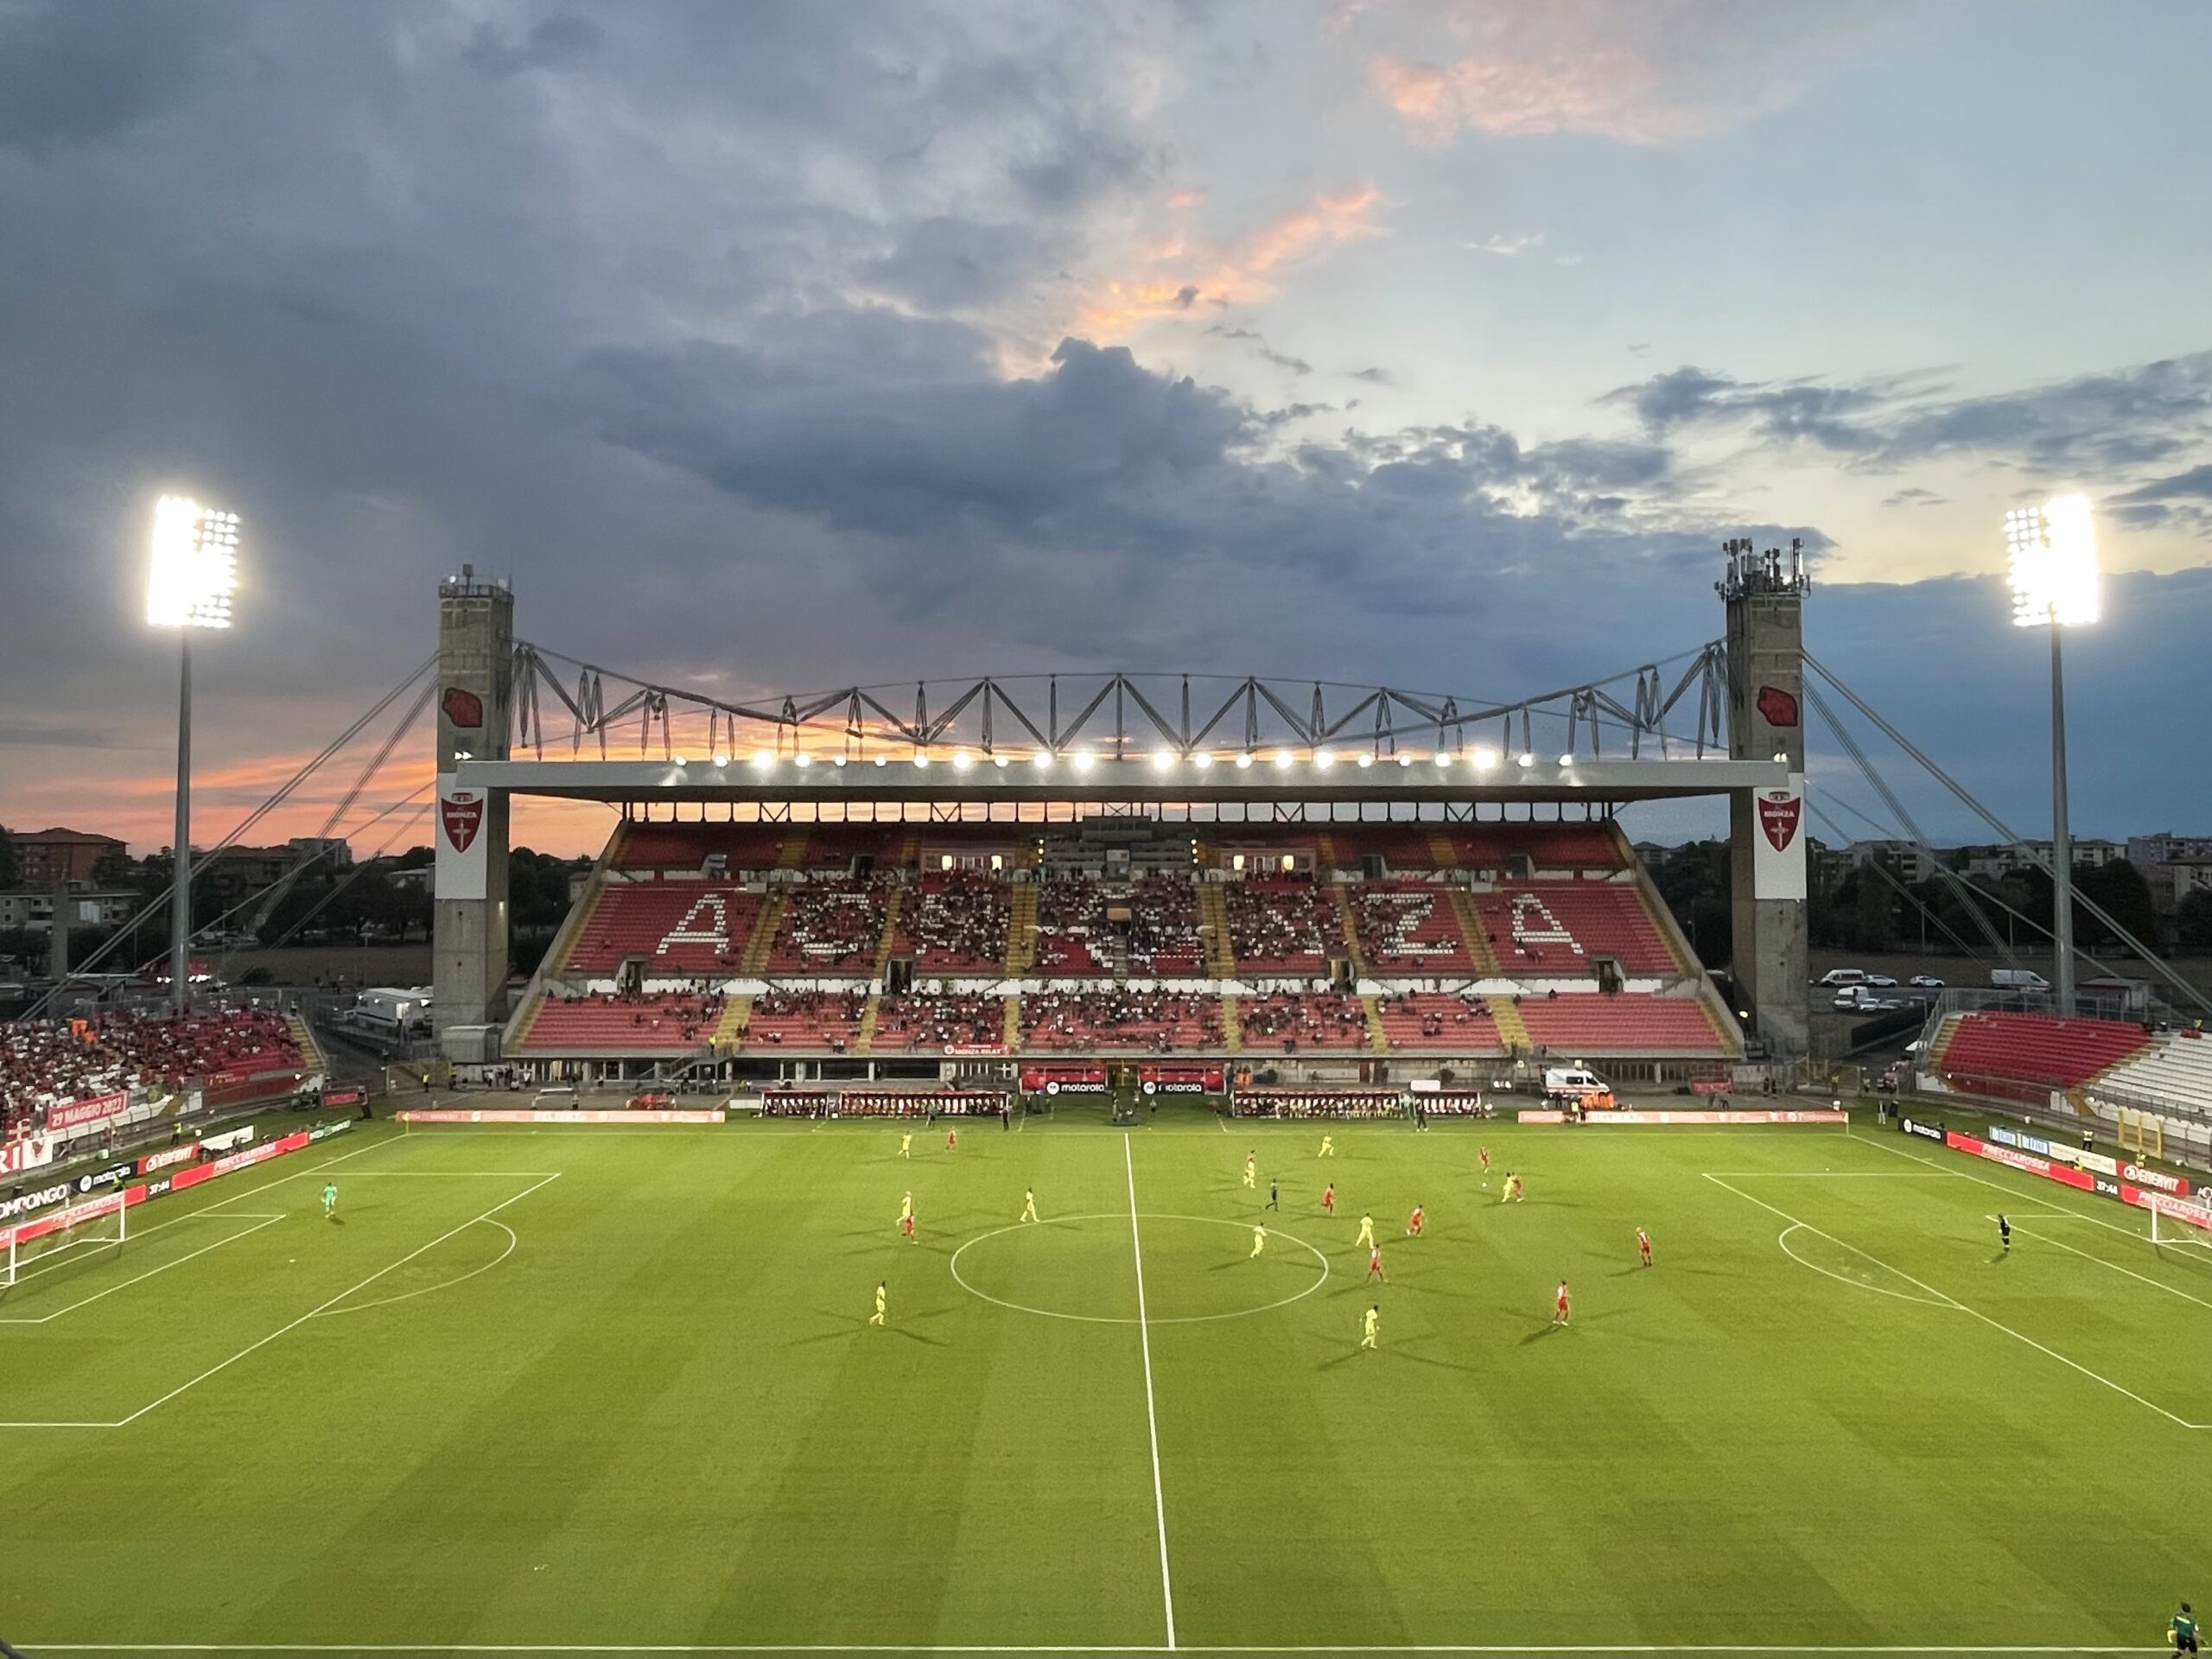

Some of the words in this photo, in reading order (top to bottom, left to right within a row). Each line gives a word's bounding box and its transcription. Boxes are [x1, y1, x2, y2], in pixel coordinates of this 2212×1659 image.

[1061, 1083, 1104, 1092] motorola
[51, 1112, 63, 1127] 29
[64, 1103, 101, 1122] MAGGIO
[1981, 1143, 2050, 1172] FRECCIAROSSA
[2138, 1169, 2179, 1192] ENERVIT
